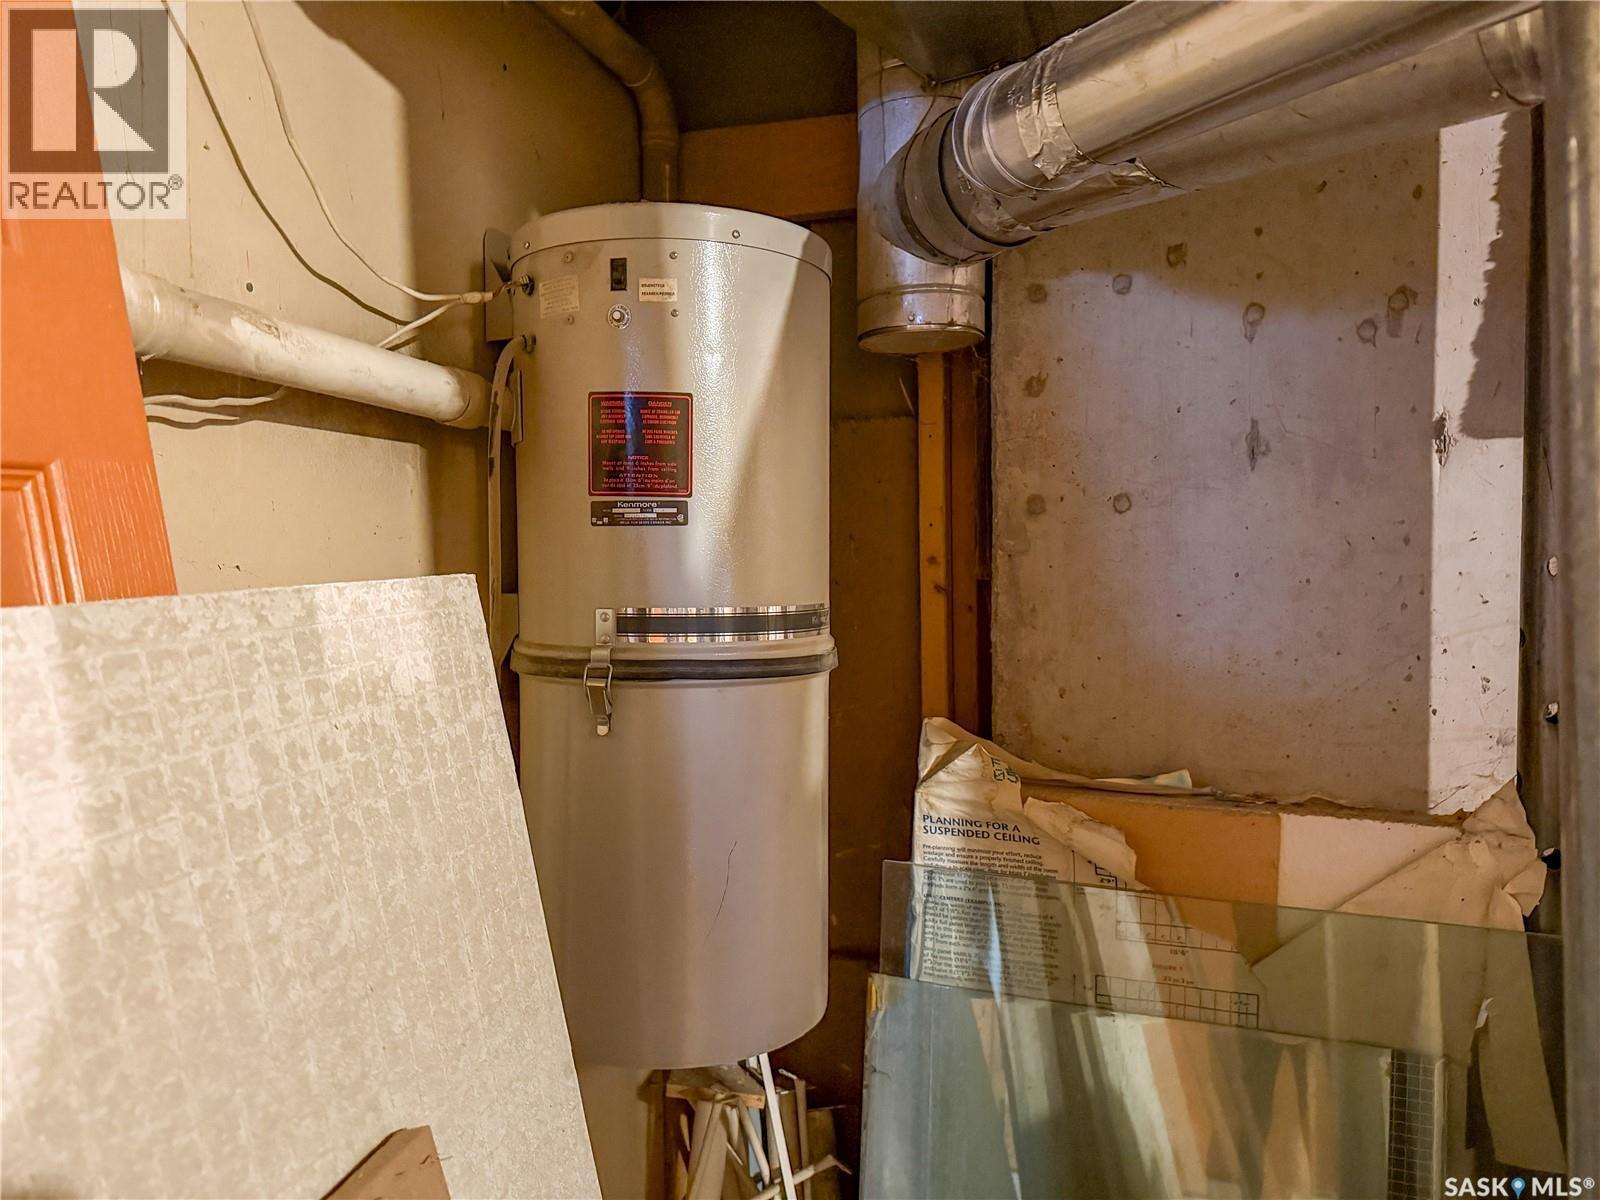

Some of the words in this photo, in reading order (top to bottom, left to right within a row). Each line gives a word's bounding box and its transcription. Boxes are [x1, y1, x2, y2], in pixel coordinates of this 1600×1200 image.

[922, 814, 983, 828] PLANNING
[986, 821, 1009, 831] FOR
[1012, 824, 1021, 833] A
[923, 825, 991, 840] SUSPENDED
[993, 831, 1041, 846] CEILING
[922, 855, 945, 864] Carefully
[979, 861, 998, 870] length
[979, 855, 1002, 863] properly
